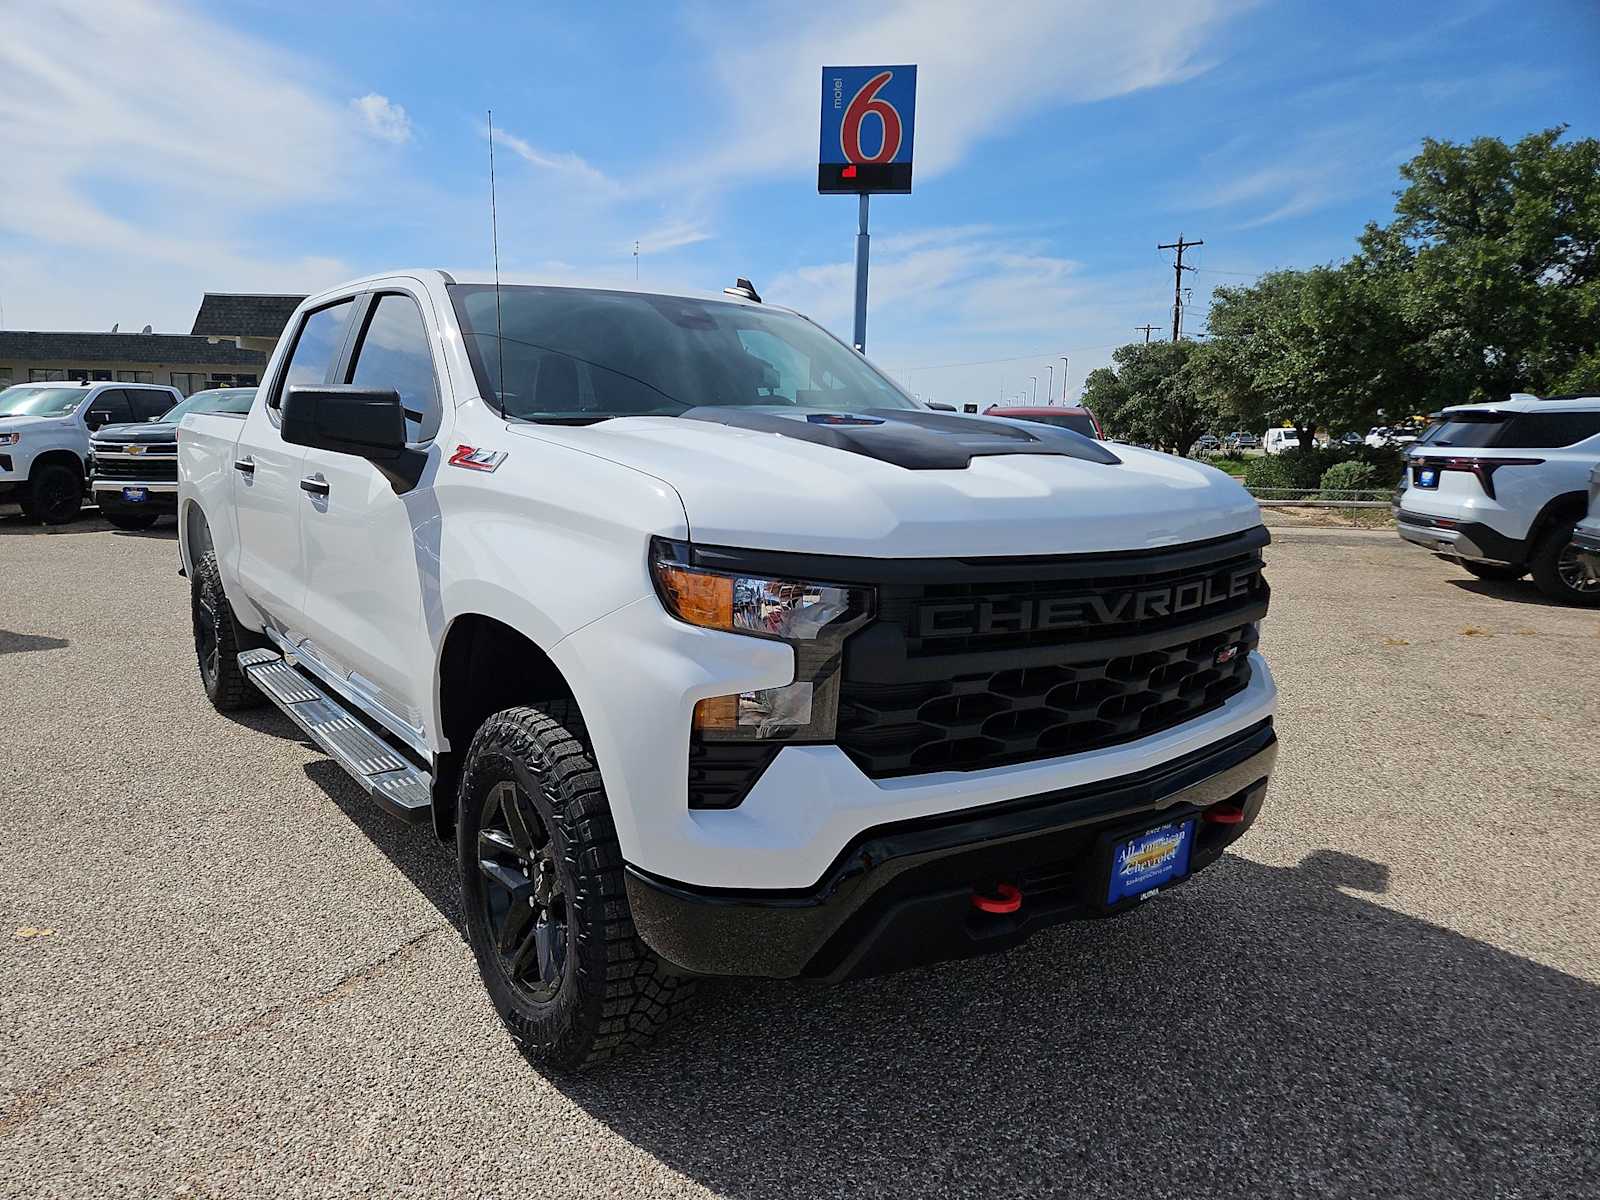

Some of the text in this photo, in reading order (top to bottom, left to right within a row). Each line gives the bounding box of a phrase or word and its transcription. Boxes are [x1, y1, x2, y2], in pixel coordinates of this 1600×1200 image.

[833, 71, 903, 164] motel 6
[447, 444, 508, 473] Z71
